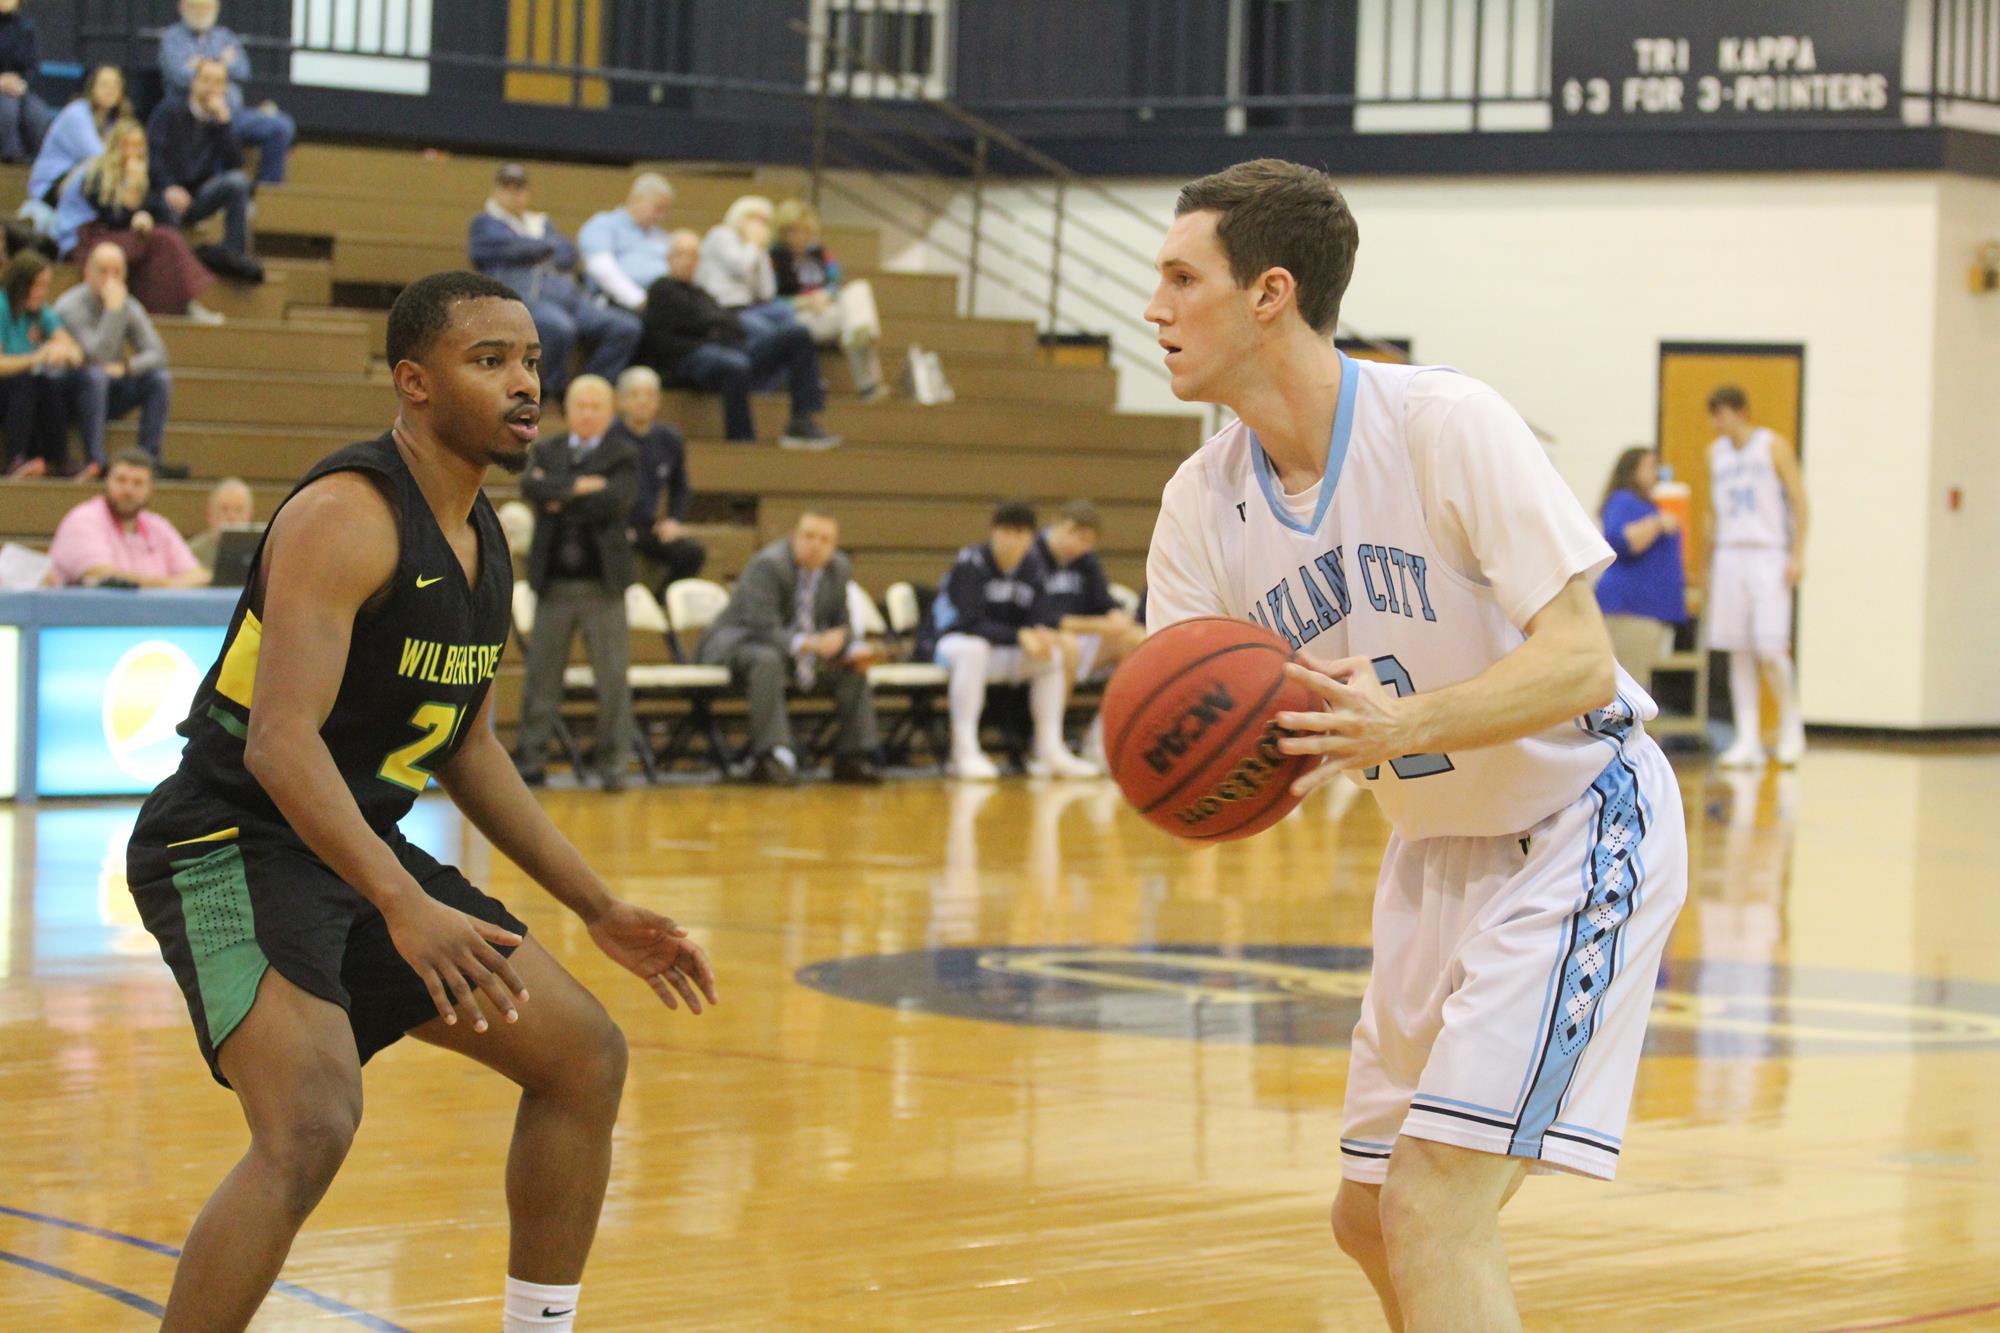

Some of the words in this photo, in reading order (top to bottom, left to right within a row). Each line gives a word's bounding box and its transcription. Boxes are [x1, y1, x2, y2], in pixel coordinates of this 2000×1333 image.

[1634, 37, 1690, 74] TRI
[1718, 36, 1817, 73] KAPPA
[1622, 75, 1684, 113] FOR
[1697, 73, 1888, 113] 3-POINTERS
[1358, 544, 1437, 622] CITY
